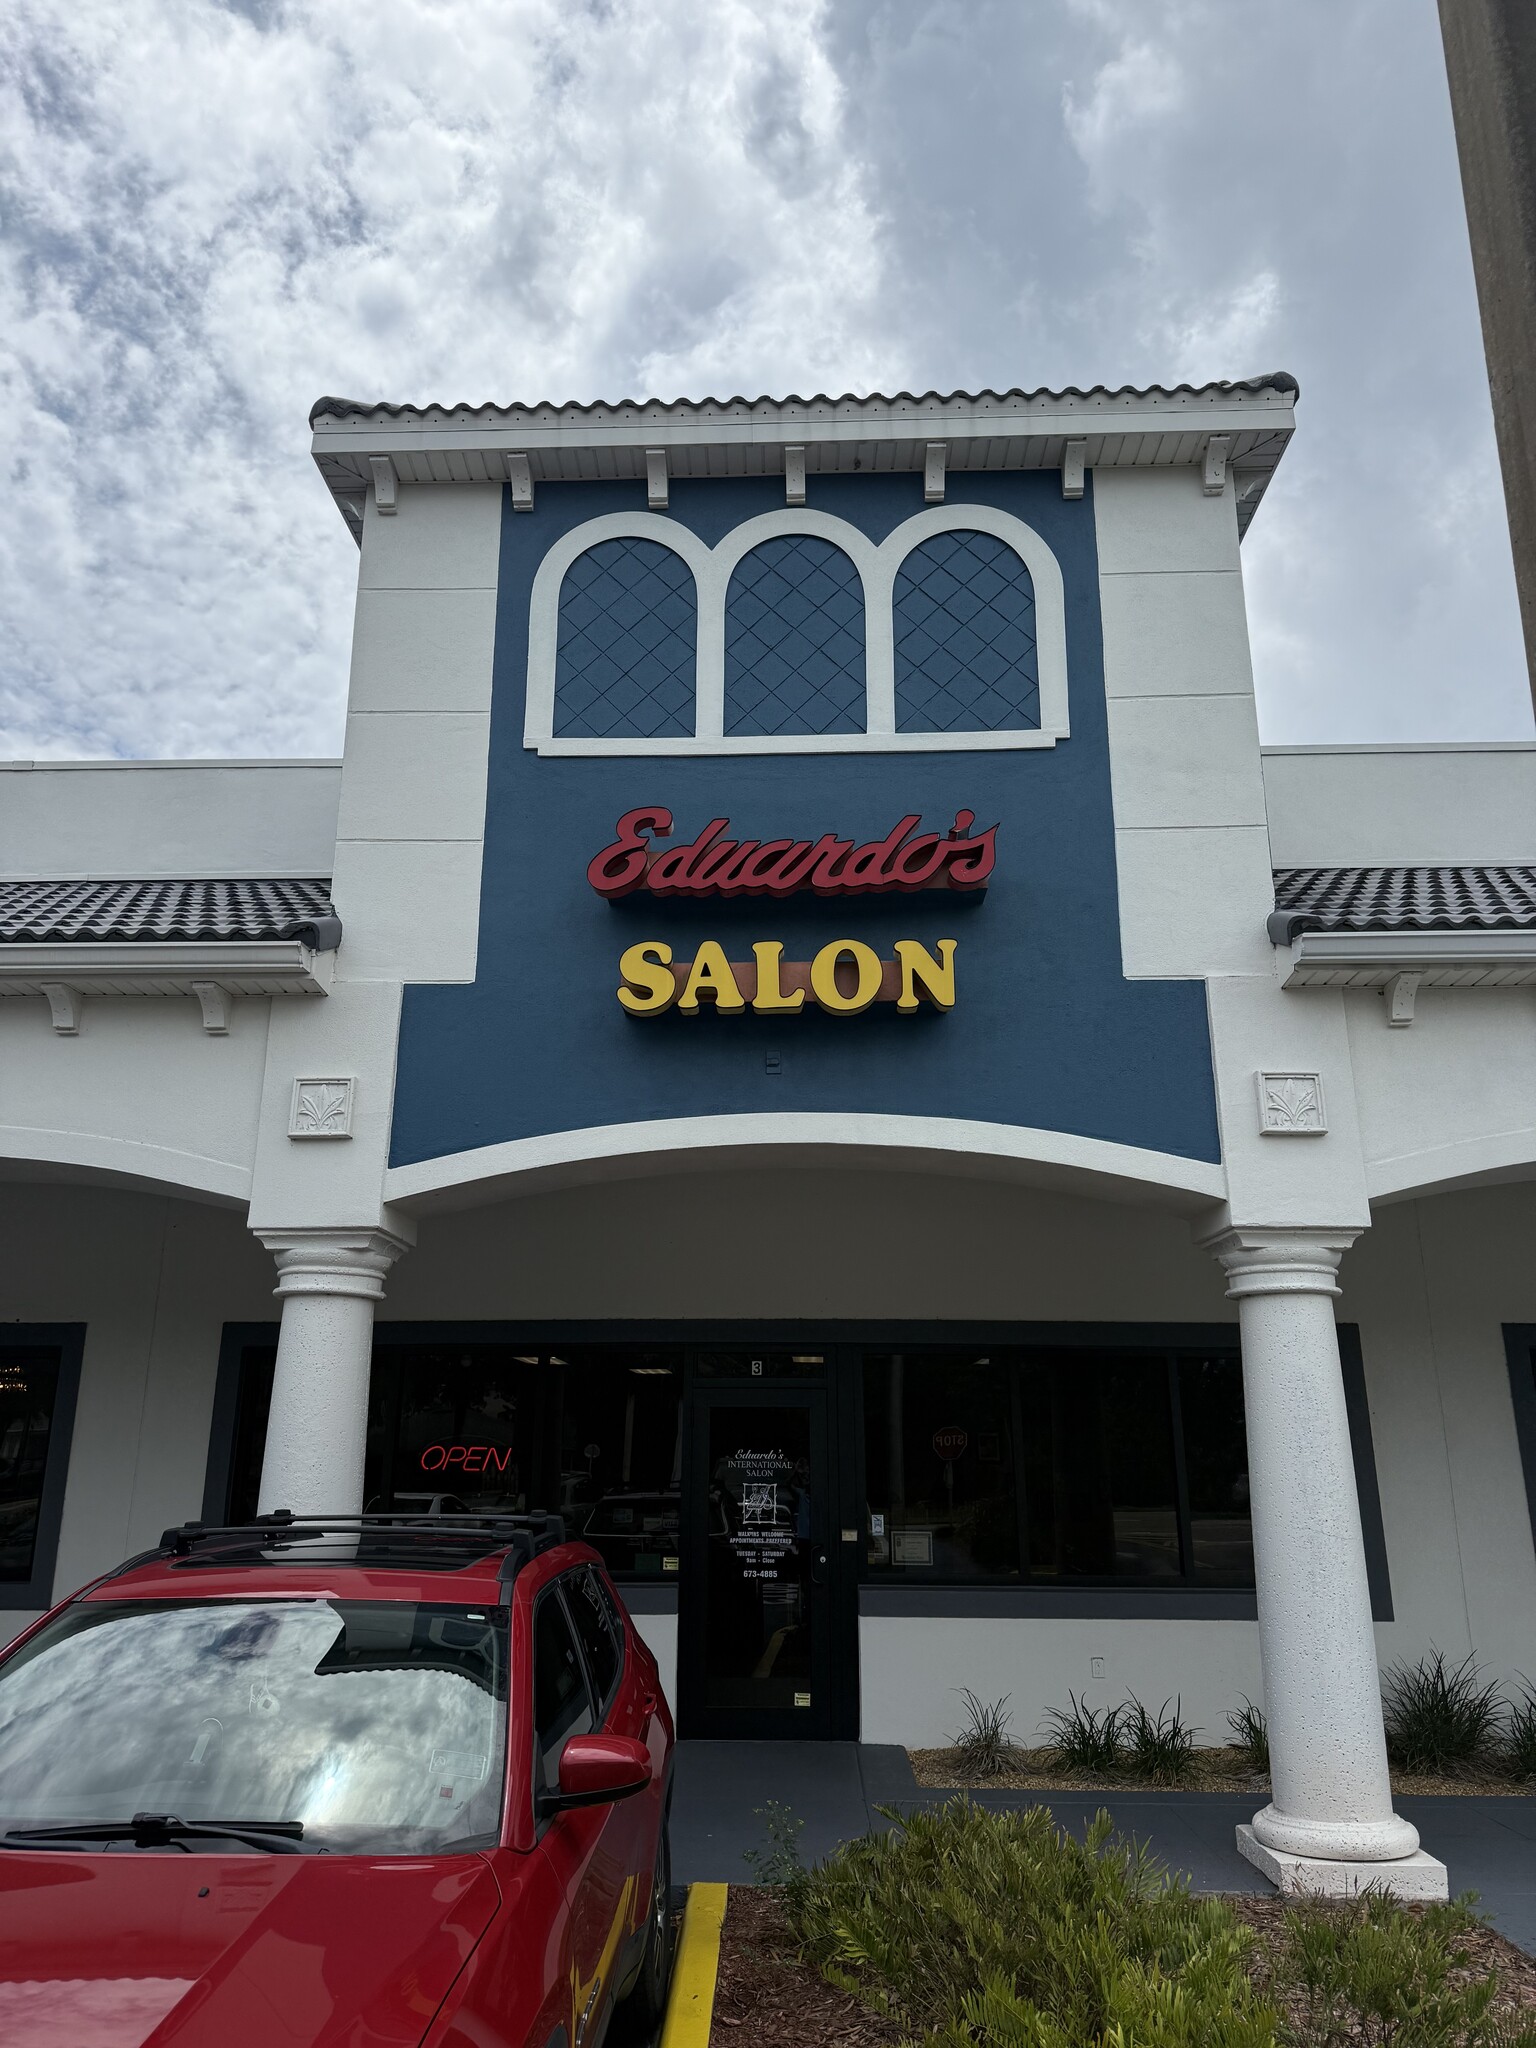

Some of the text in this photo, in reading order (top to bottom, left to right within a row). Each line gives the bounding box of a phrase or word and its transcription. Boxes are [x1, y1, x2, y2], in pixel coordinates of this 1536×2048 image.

[587, 806, 1000, 898] Eduardo's
[616, 939, 958, 1017] SALON
[753, 1362, 761, 1375] 3
[420, 1445, 512, 1472] OPEN
[735, 1449, 784, 1460] Eduardo's
[728, 1460, 792, 1469] INTERNATIONAL
[746, 1469, 774, 1477] SALON
[743, 1570, 778, 1578] 673-4885
